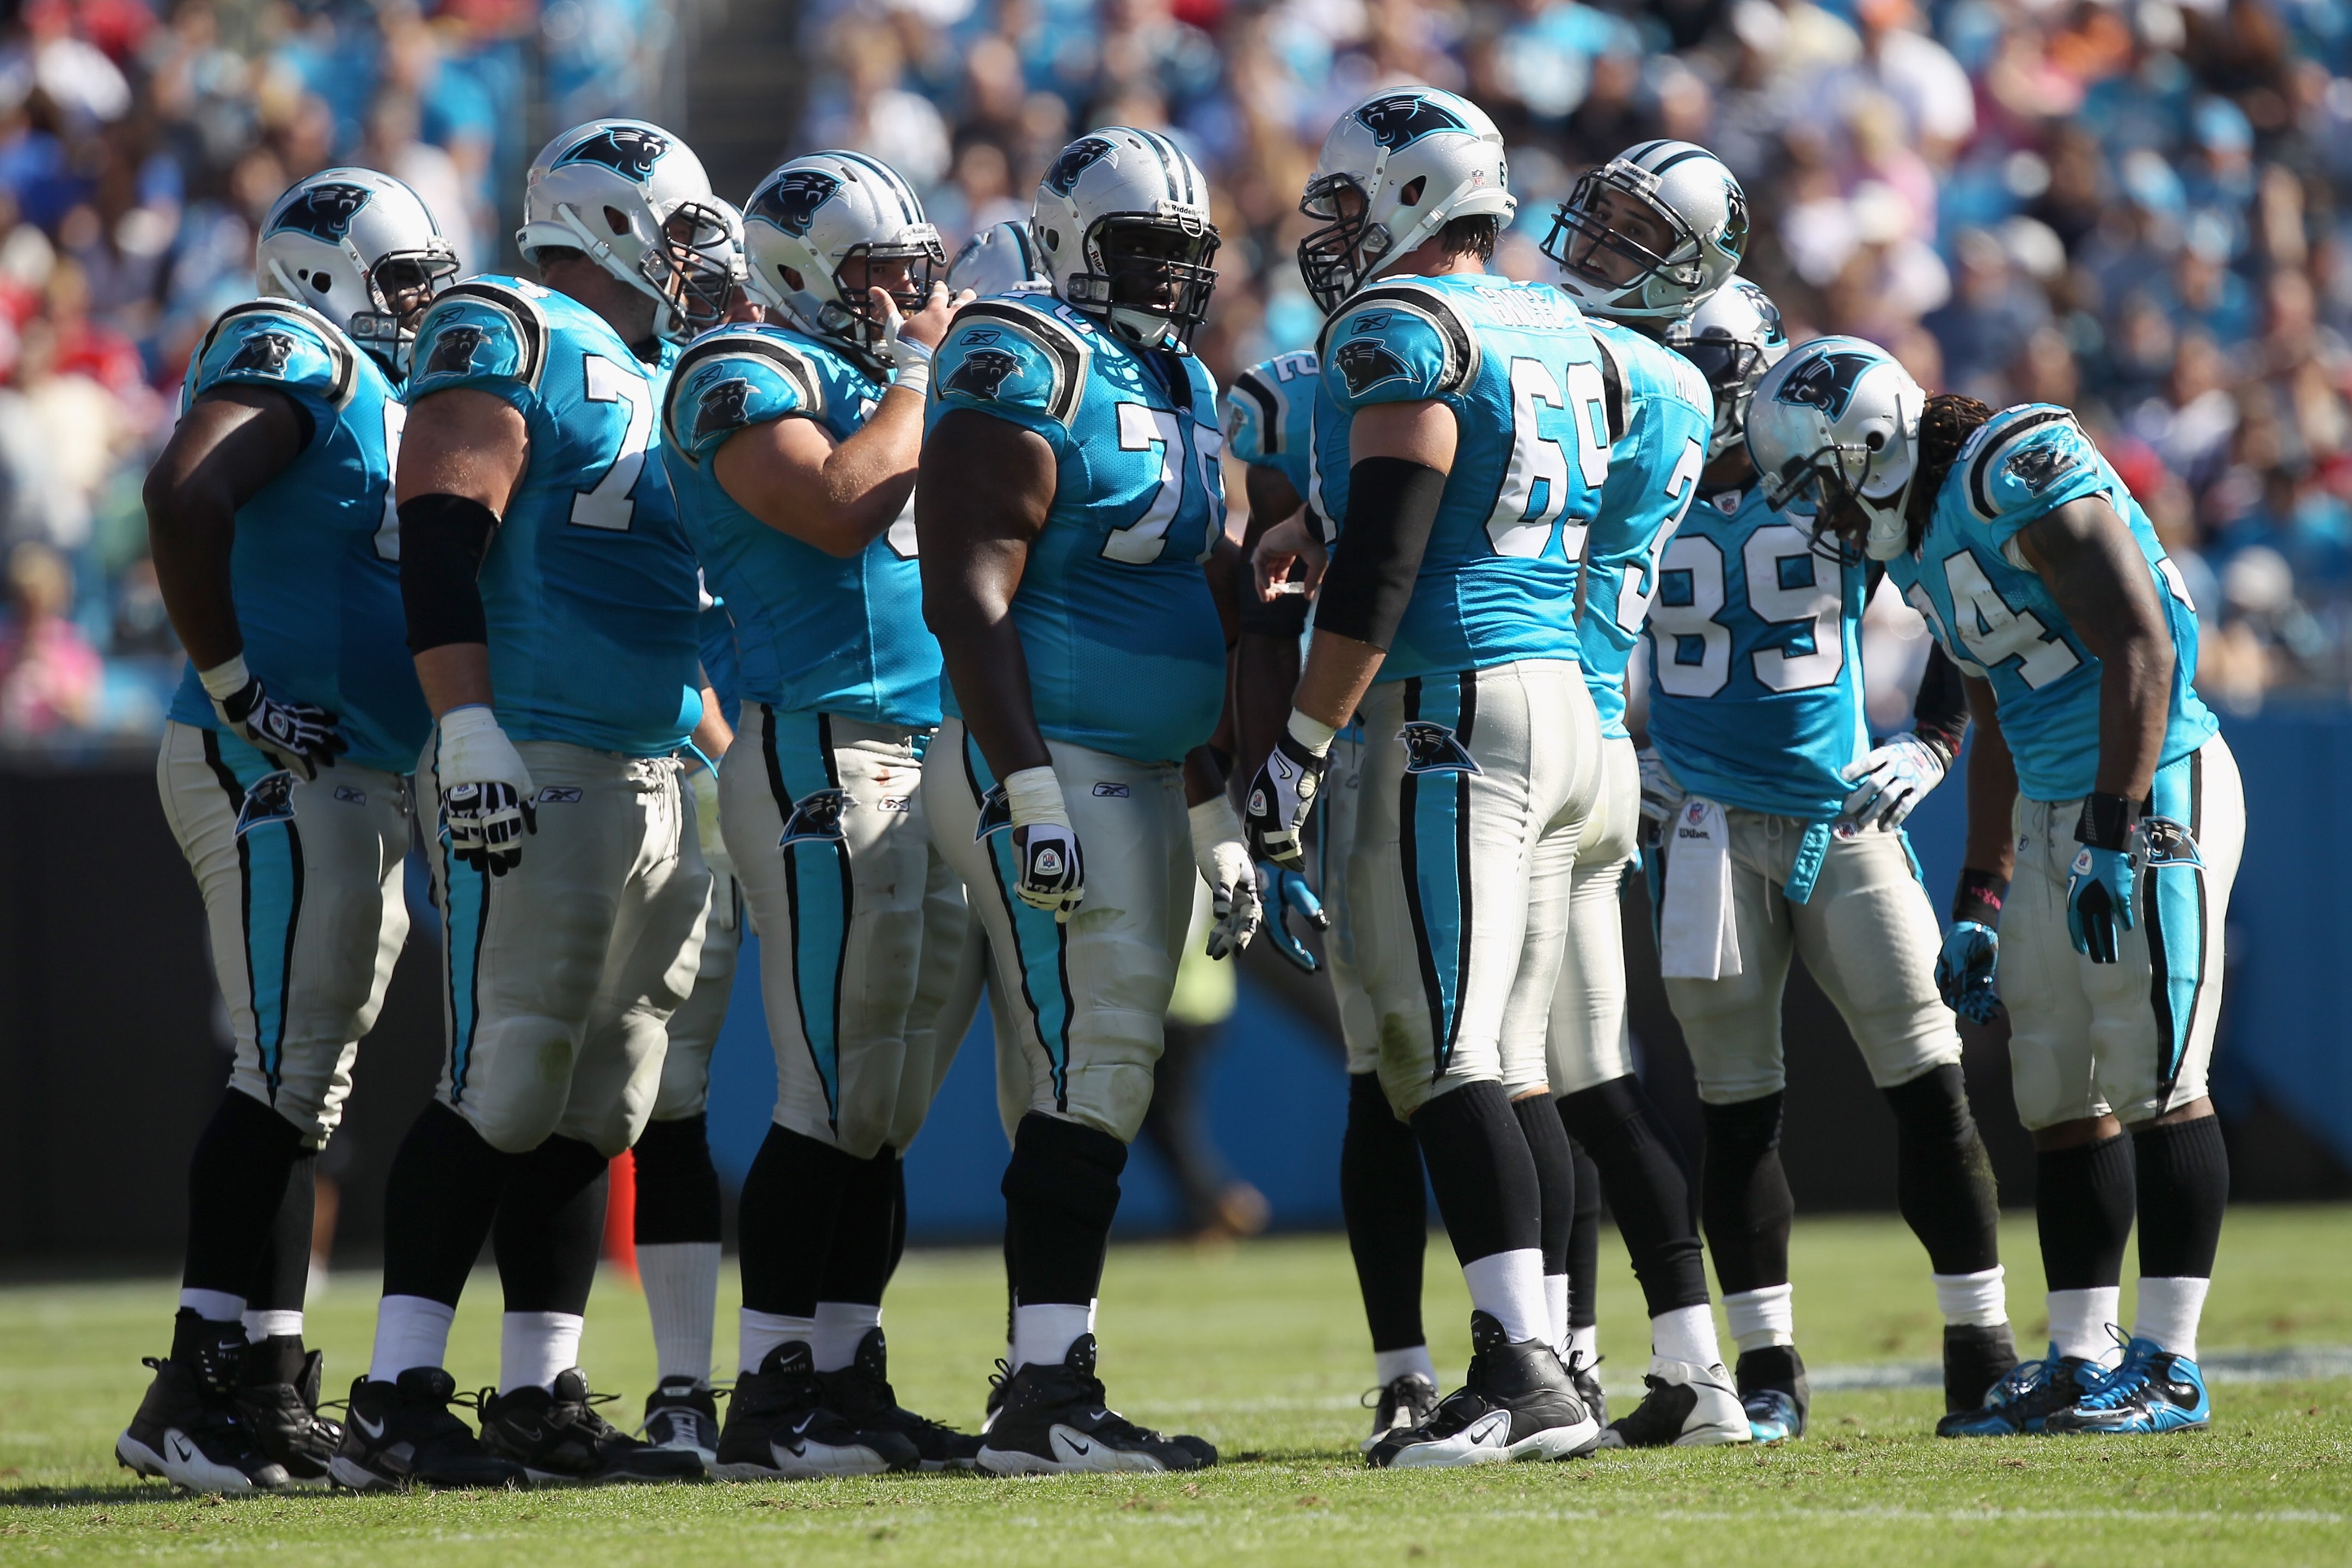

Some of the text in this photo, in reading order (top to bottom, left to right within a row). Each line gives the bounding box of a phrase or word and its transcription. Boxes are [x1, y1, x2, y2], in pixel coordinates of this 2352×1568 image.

[1485, 356, 1610, 562] 69
[1616, 436, 1704, 635] 3
[1646, 524, 1843, 699] 89
